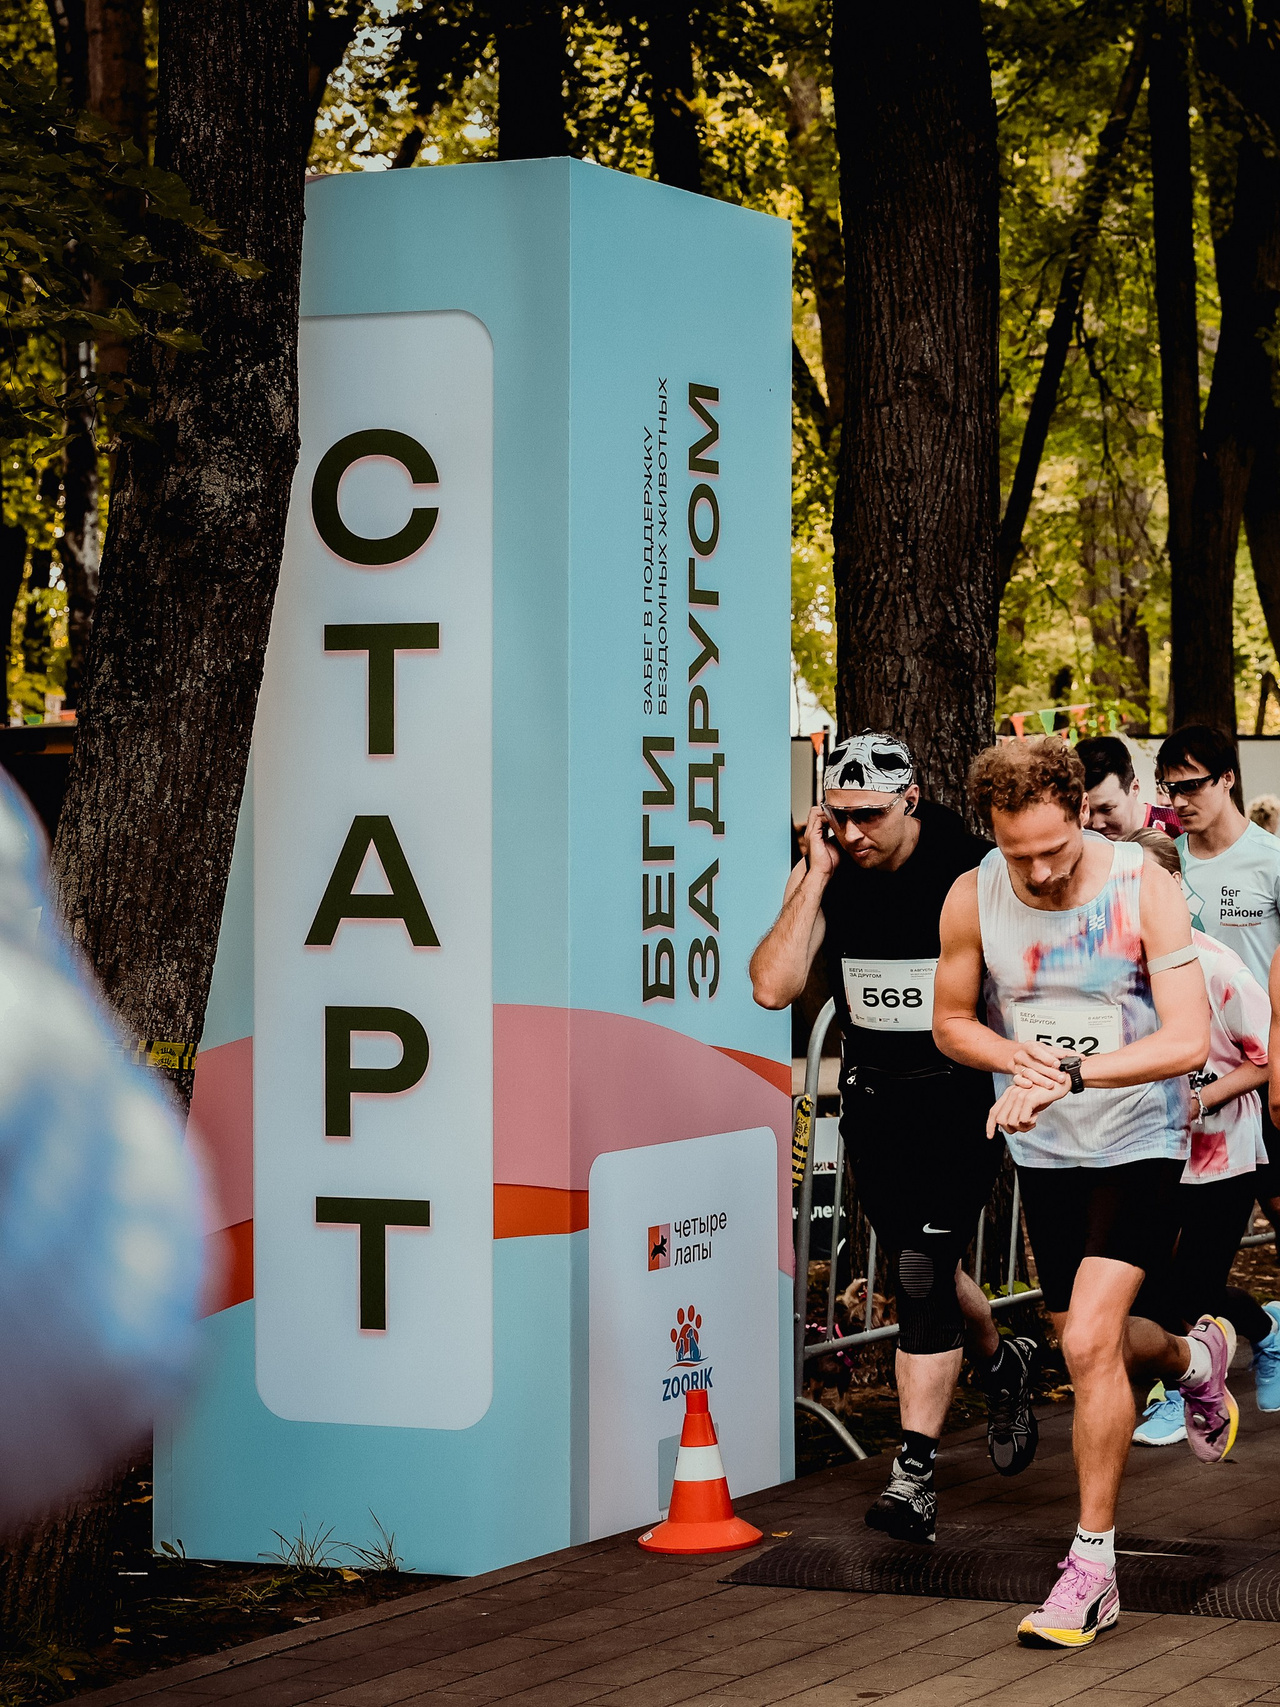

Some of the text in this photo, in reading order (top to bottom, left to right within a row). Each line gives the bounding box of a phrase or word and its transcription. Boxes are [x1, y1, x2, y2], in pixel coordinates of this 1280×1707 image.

[658, 377, 668, 715] БЕЗДОМНЫХ ЖИВОТНЫХ
[643, 426, 654, 715] ЗАБЕГ В ПОДДЕРЖКУ
[688, 382, 725, 999] ЗА ДРУГОМ
[304, 428, 441, 1331] СТАРТ
[642, 736, 675, 1003] БЕГИ
[1220, 898, 1234, 906] на
[1221, 886, 1241, 897] бег
[1220, 906, 1263, 919] районе
[862, 987, 923, 1008] 568
[674, 1211, 727, 1238] четыре
[674, 1241, 712, 1266] лапы
[662, 1366, 714, 1401] ZOORIK
